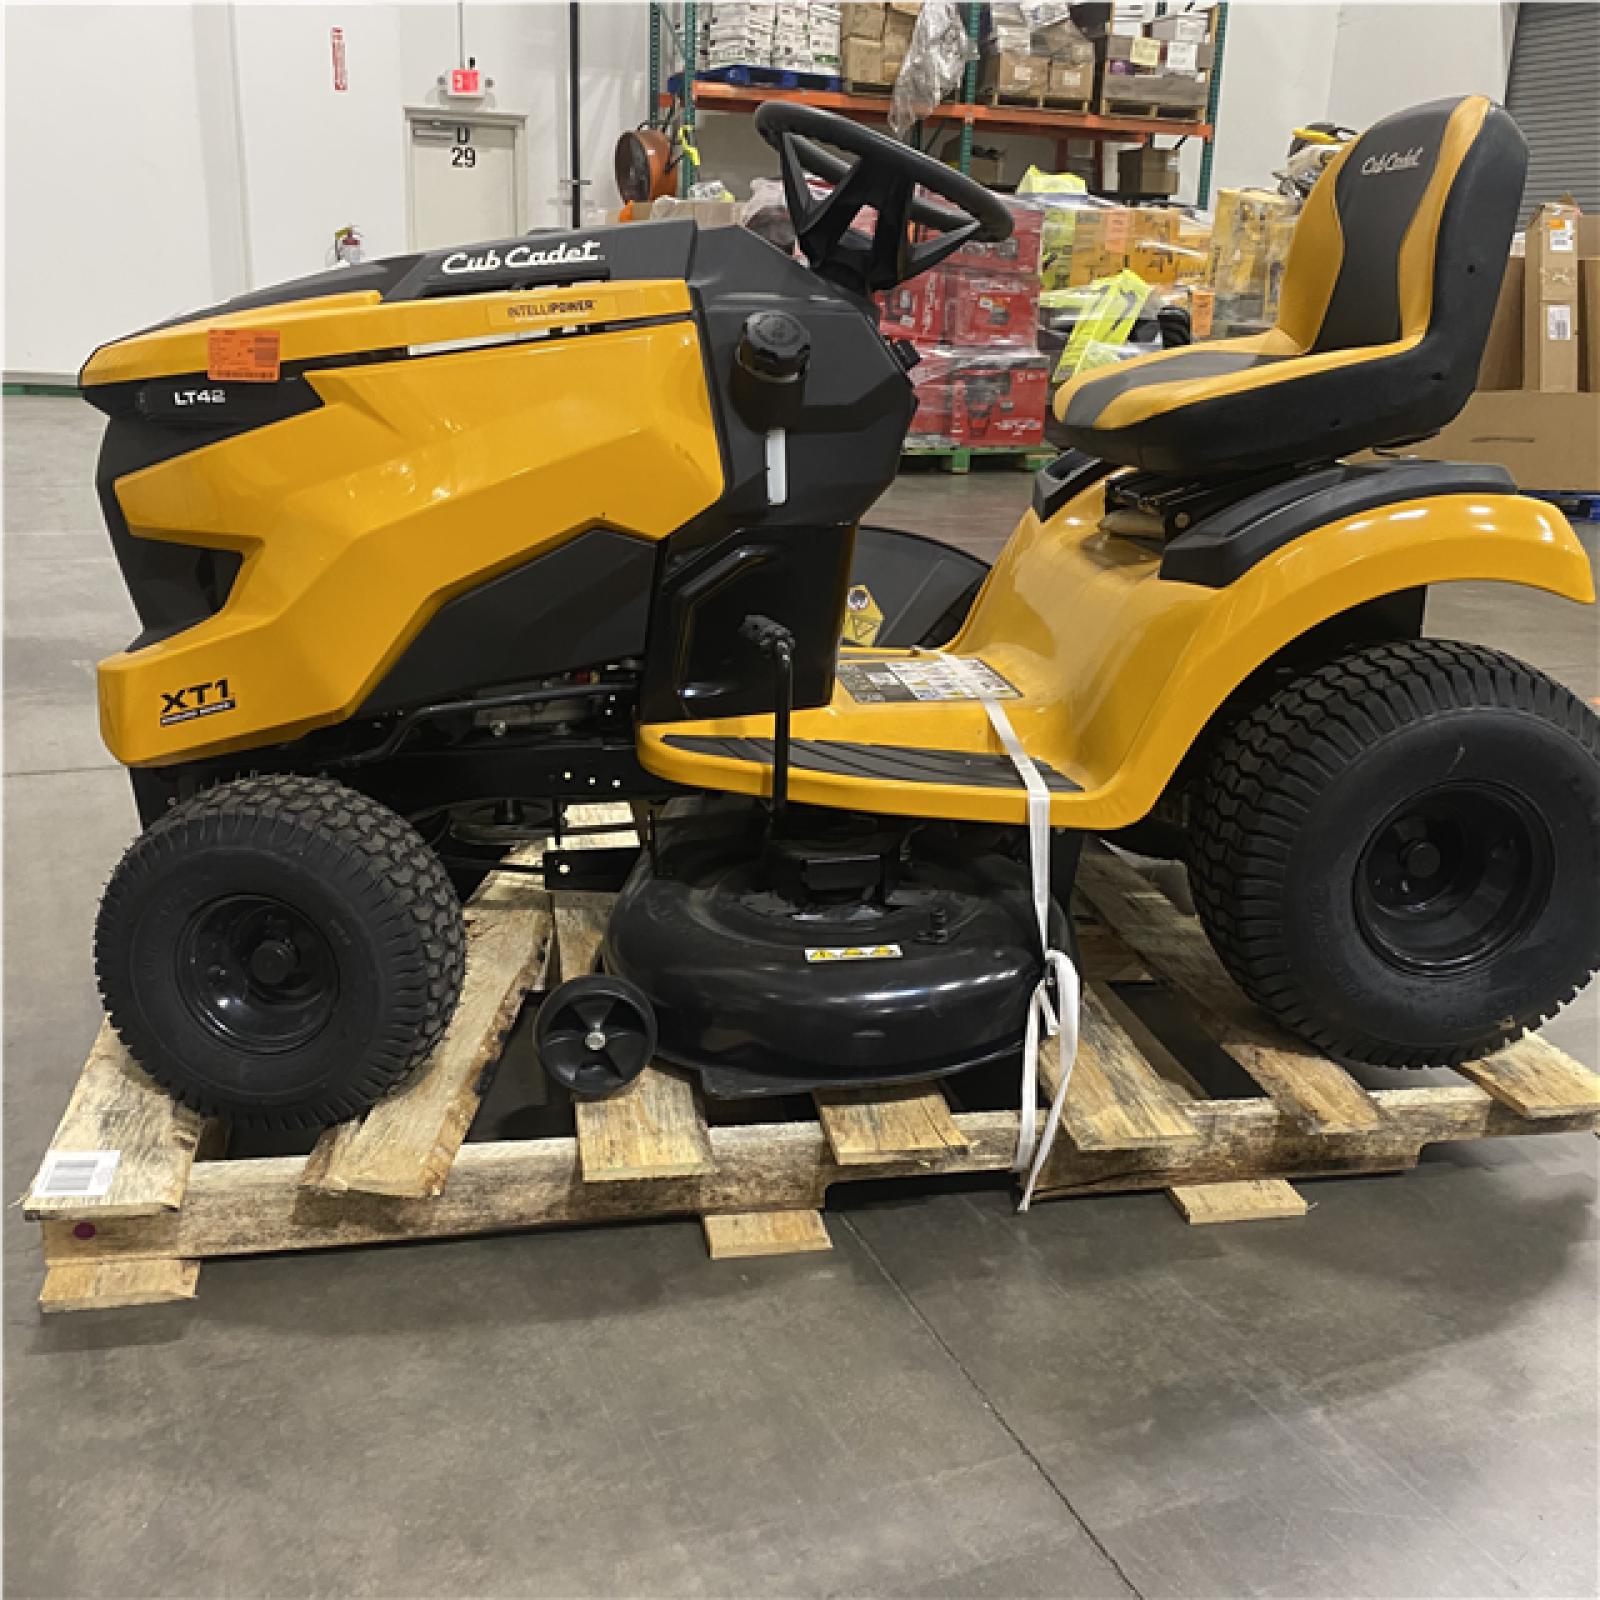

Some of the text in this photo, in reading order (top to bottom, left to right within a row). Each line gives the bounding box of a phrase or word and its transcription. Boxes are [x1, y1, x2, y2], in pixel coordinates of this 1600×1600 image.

[452, 147, 476, 168] 29
[441, 240, 601, 275] Cub Cadet
[507, 299, 597, 318] INTELLIPOWER
[174, 389, 226, 406] LT42
[160, 679, 228, 713] XT1
